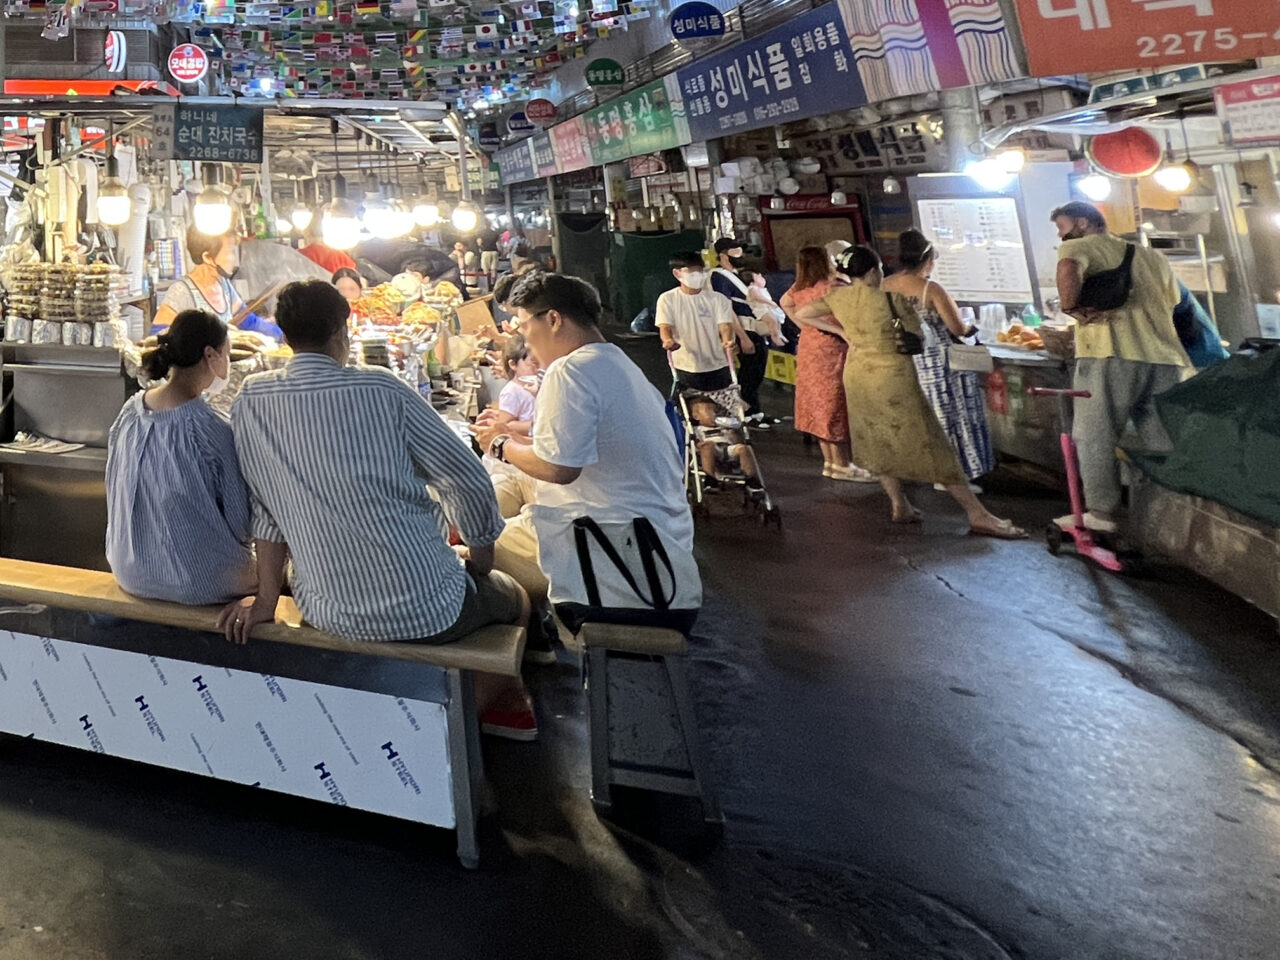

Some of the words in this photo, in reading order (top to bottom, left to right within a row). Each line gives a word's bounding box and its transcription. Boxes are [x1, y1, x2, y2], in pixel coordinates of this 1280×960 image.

[673, 14, 721, 34] 성미식품
[709, 42, 792, 109] 성미식품
[180, 110, 217, 123] 하니네
[155, 127, 170, 137] 64
[178, 125, 203, 143] 순대
[189, 146, 258, 161] 2268-6738
